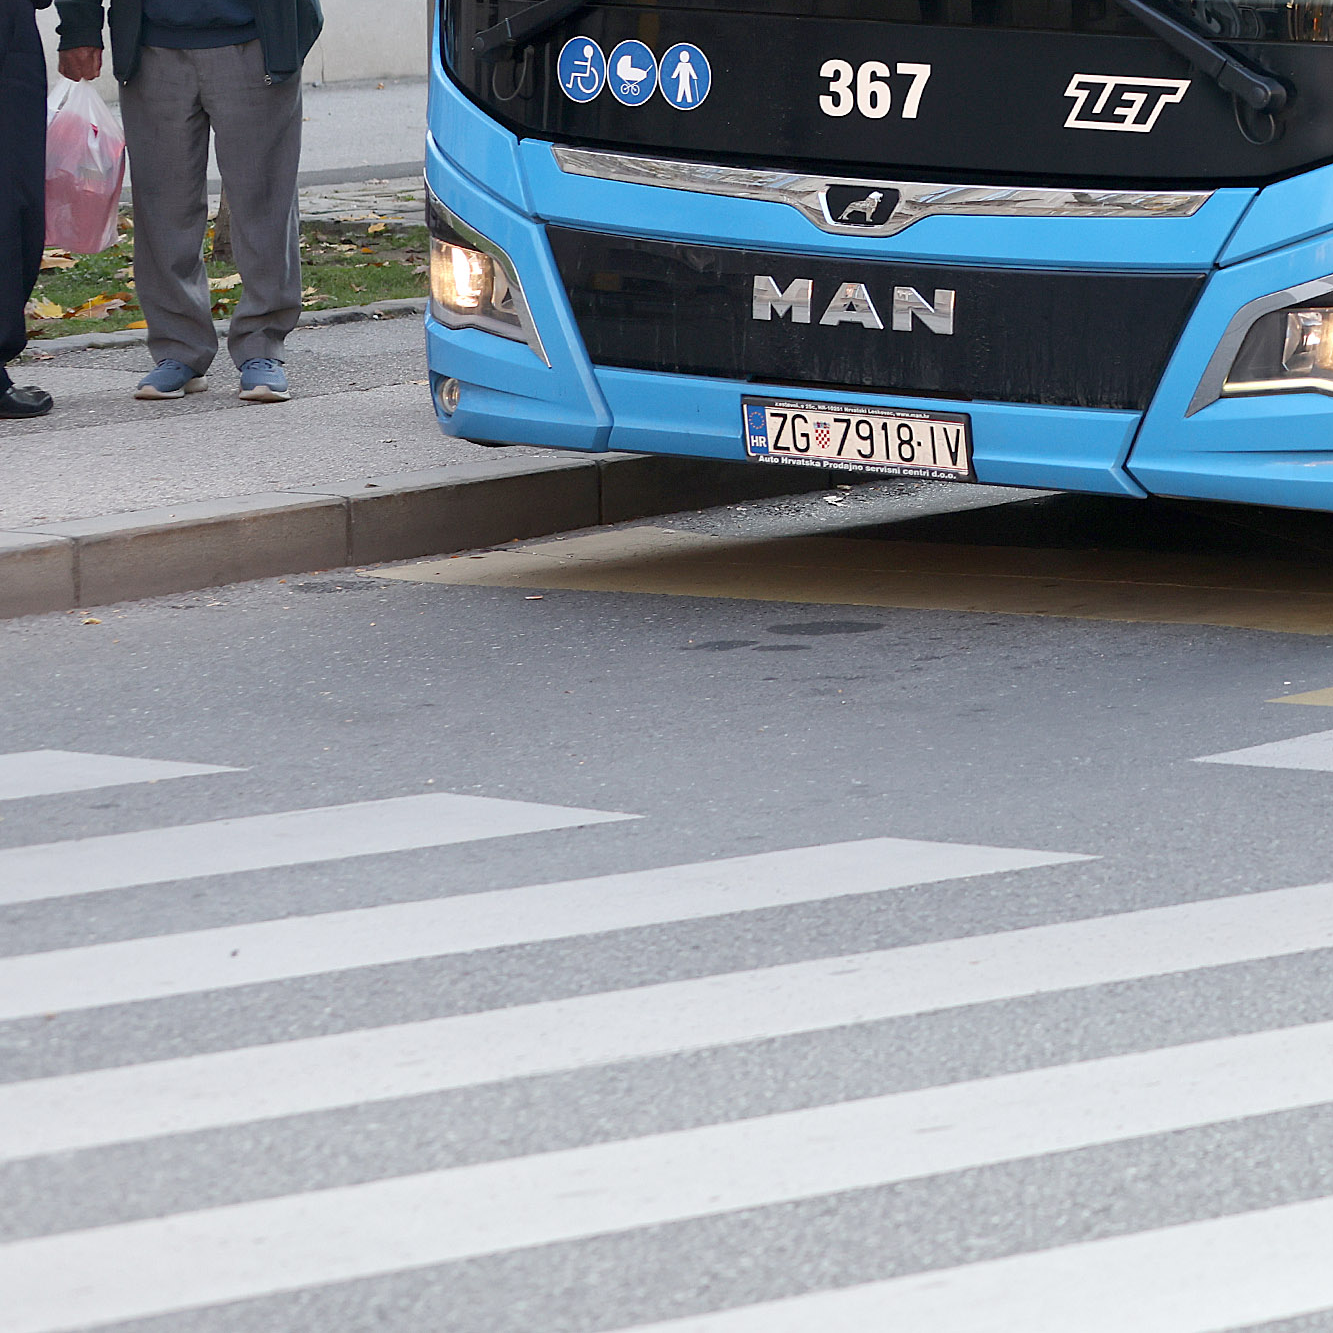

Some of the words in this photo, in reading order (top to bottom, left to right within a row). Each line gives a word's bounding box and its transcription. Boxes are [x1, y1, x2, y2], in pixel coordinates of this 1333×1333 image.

[820, 58, 932, 120] 367
[1063, 73, 1192, 134] ZET
[752, 274, 957, 336] MAN
[750, 435, 767, 447] HR
[769, 412, 811, 453] ZG
[758, 455, 780, 464] Auto
[781, 456, 821, 467] Hrvatska
[822, 461, 863, 472] Prodajno
[866, 465, 901, 475] servisni
[902, 467, 930, 477] centri
[931, 470, 957, 480] d.o.o.
